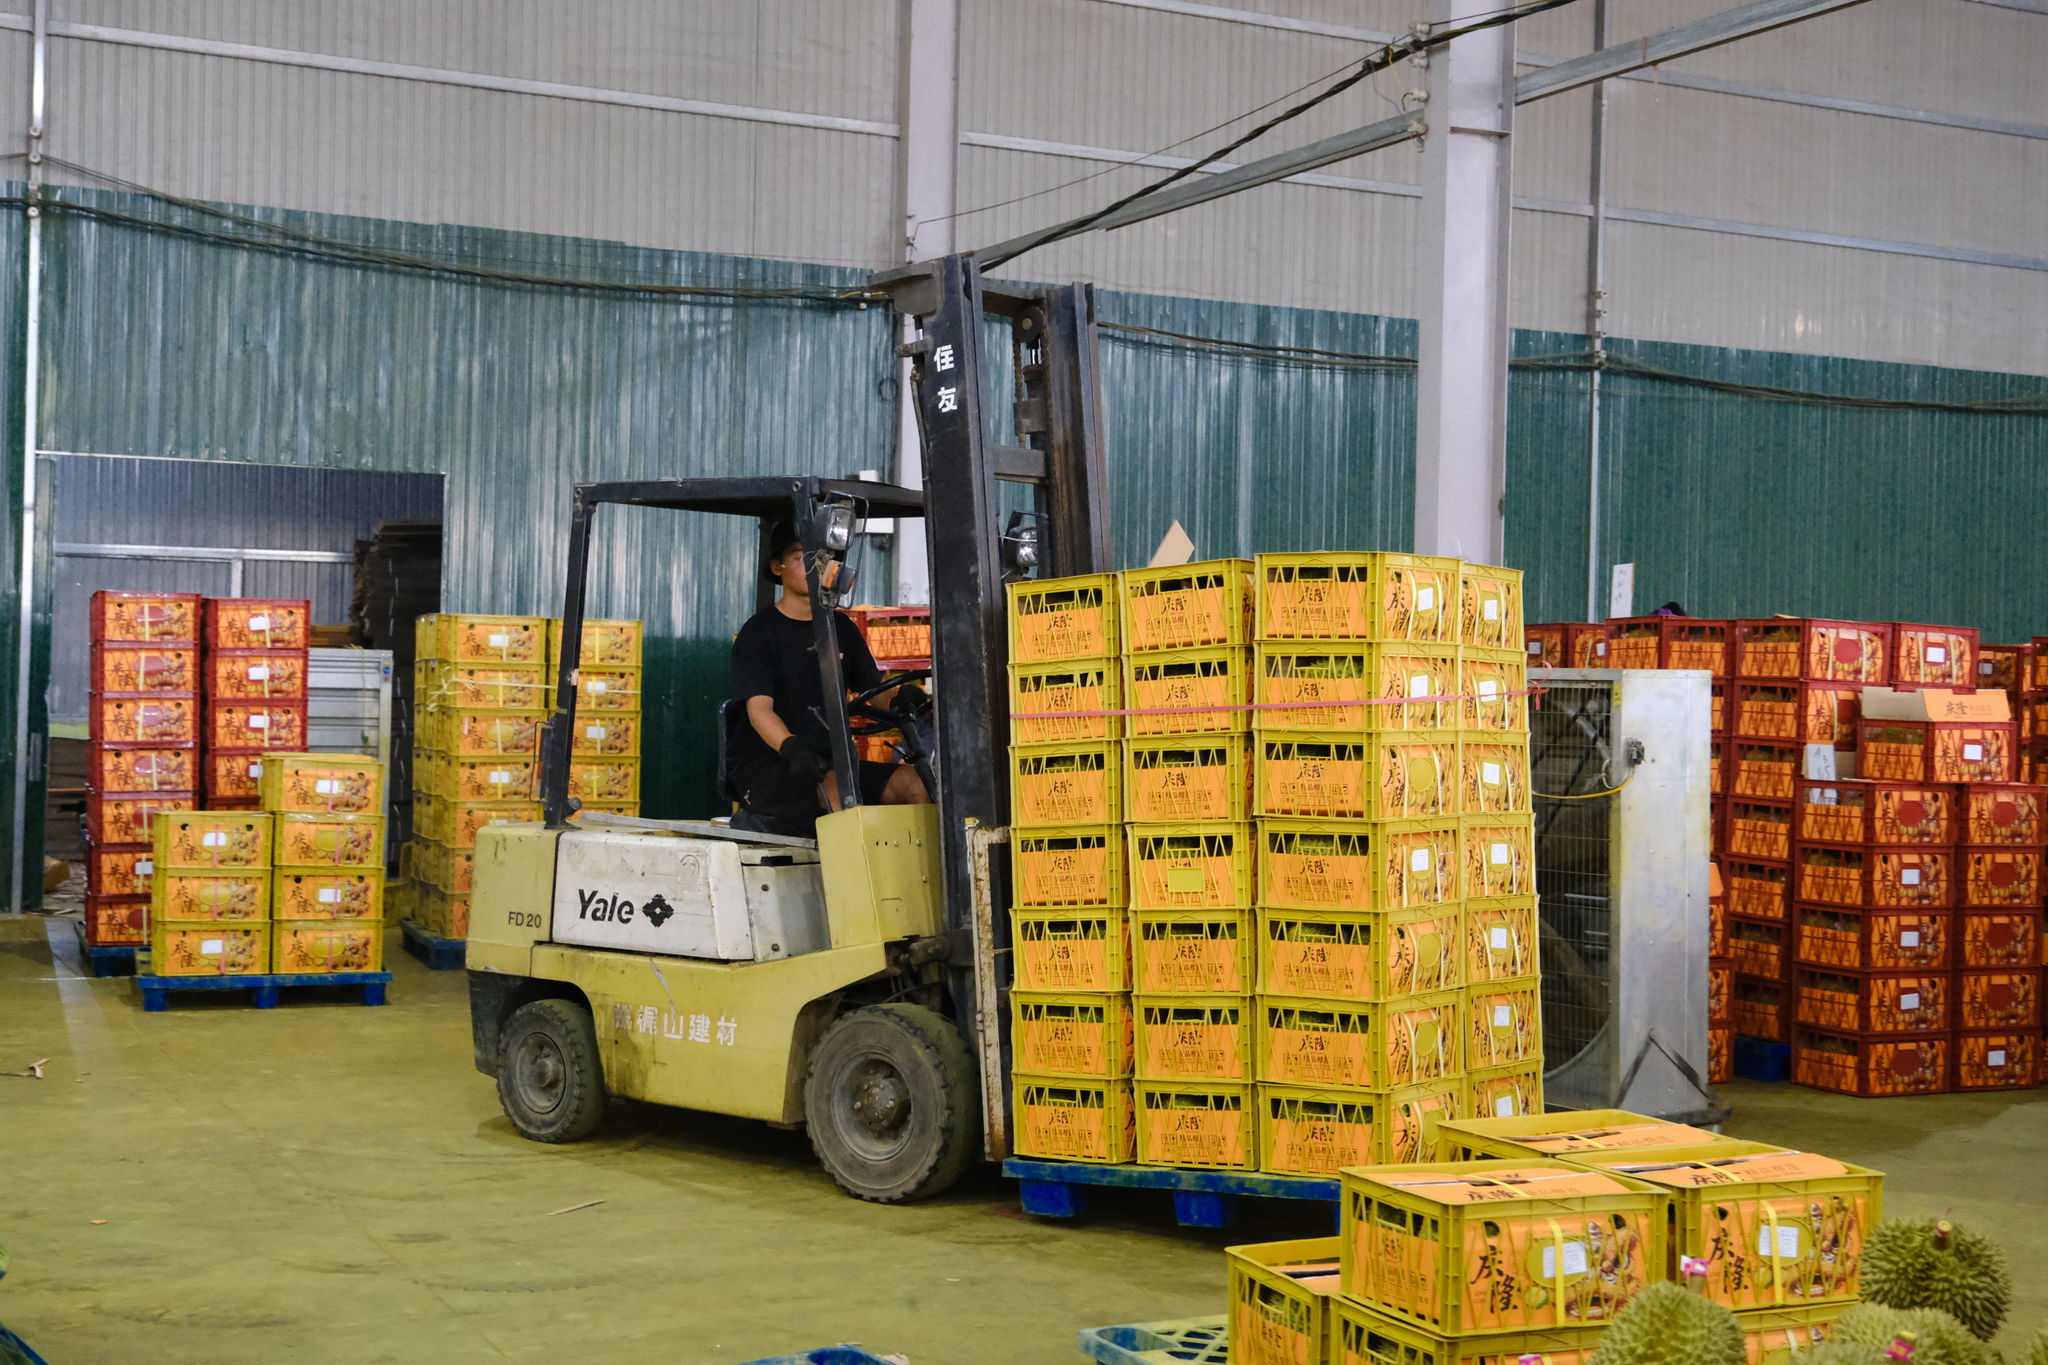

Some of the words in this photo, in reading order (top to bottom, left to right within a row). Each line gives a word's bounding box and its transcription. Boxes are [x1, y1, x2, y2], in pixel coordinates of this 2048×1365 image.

[933, 344, 958, 413] 住友
[578, 888, 634, 924] Yale
[1470, 1244, 1521, 1314] 庆隆
[1709, 1227, 1752, 1294] 庆隆
